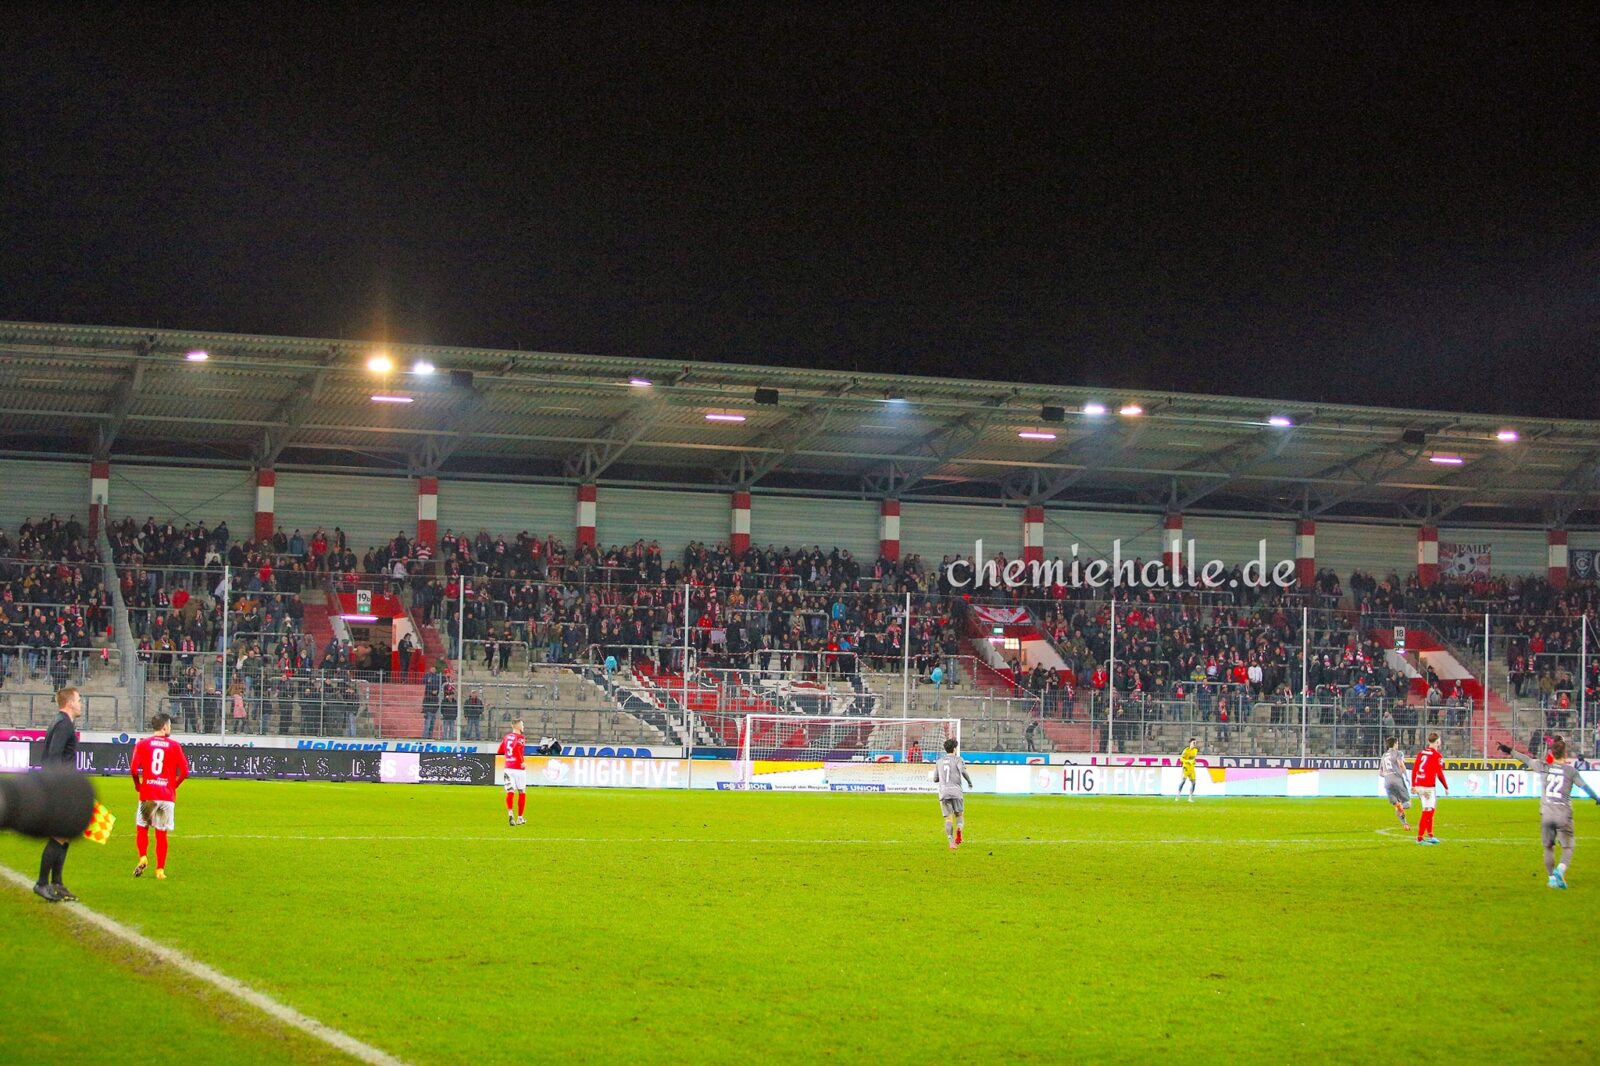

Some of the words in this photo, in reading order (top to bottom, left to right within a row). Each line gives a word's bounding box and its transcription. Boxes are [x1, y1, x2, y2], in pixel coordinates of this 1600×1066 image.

[506, 741, 513, 756] 5
[151, 748, 165, 775] 8
[574, 760, 625, 785] HIGH
[632, 761, 680, 787] FIVE
[1418, 755, 1427, 773] 2
[1063, 768, 1109, 792] HIGH
[1113, 767, 1155, 792] FIVE
[1545, 774, 1564, 798] 22
